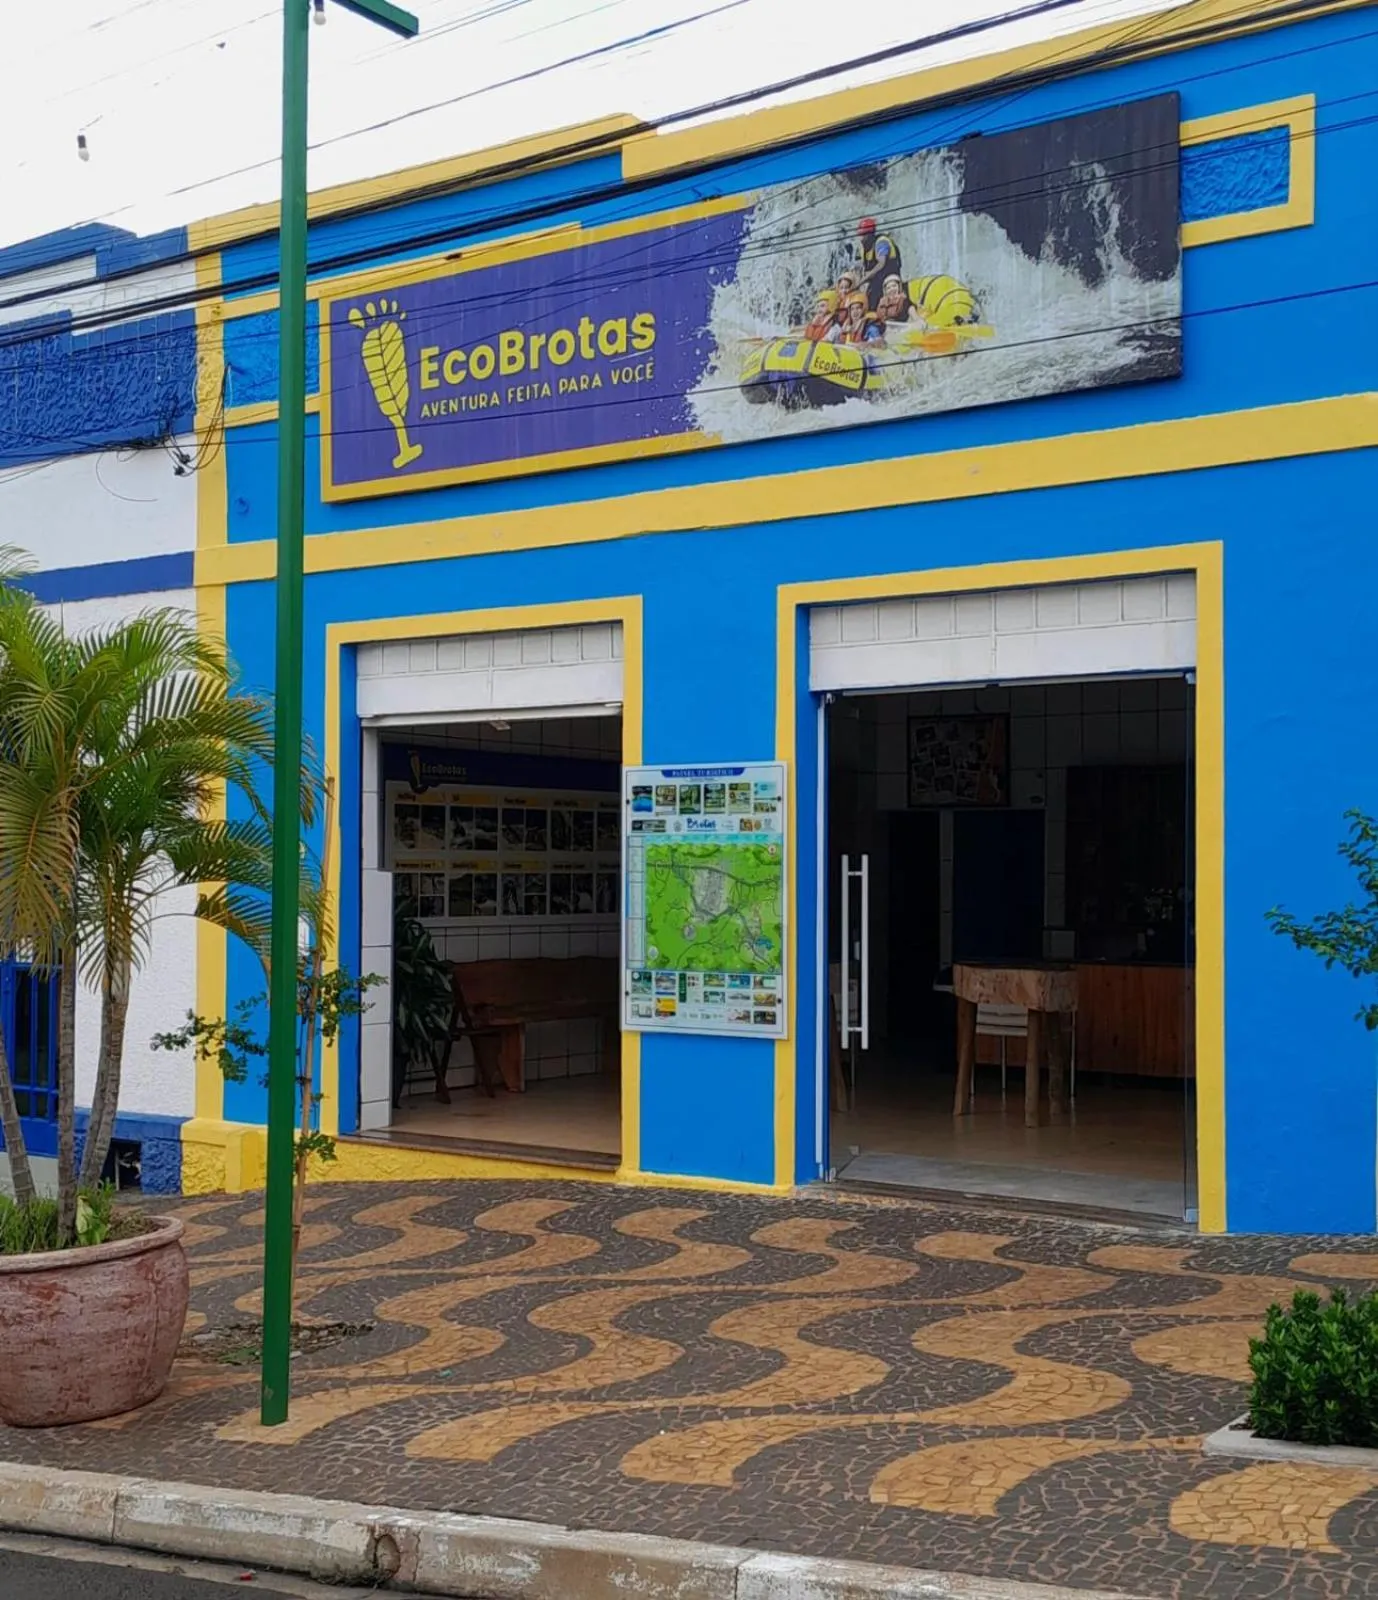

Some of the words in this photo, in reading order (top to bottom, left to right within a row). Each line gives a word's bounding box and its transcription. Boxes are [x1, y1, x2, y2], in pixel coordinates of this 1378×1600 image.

[420, 312, 656, 390] EcoBrotas
[420, 392, 500, 418] AVENTURA
[508, 382, 552, 404] FEITA
[559, 372, 603, 395] PARA
[611, 356, 655, 385] VOCÊ
